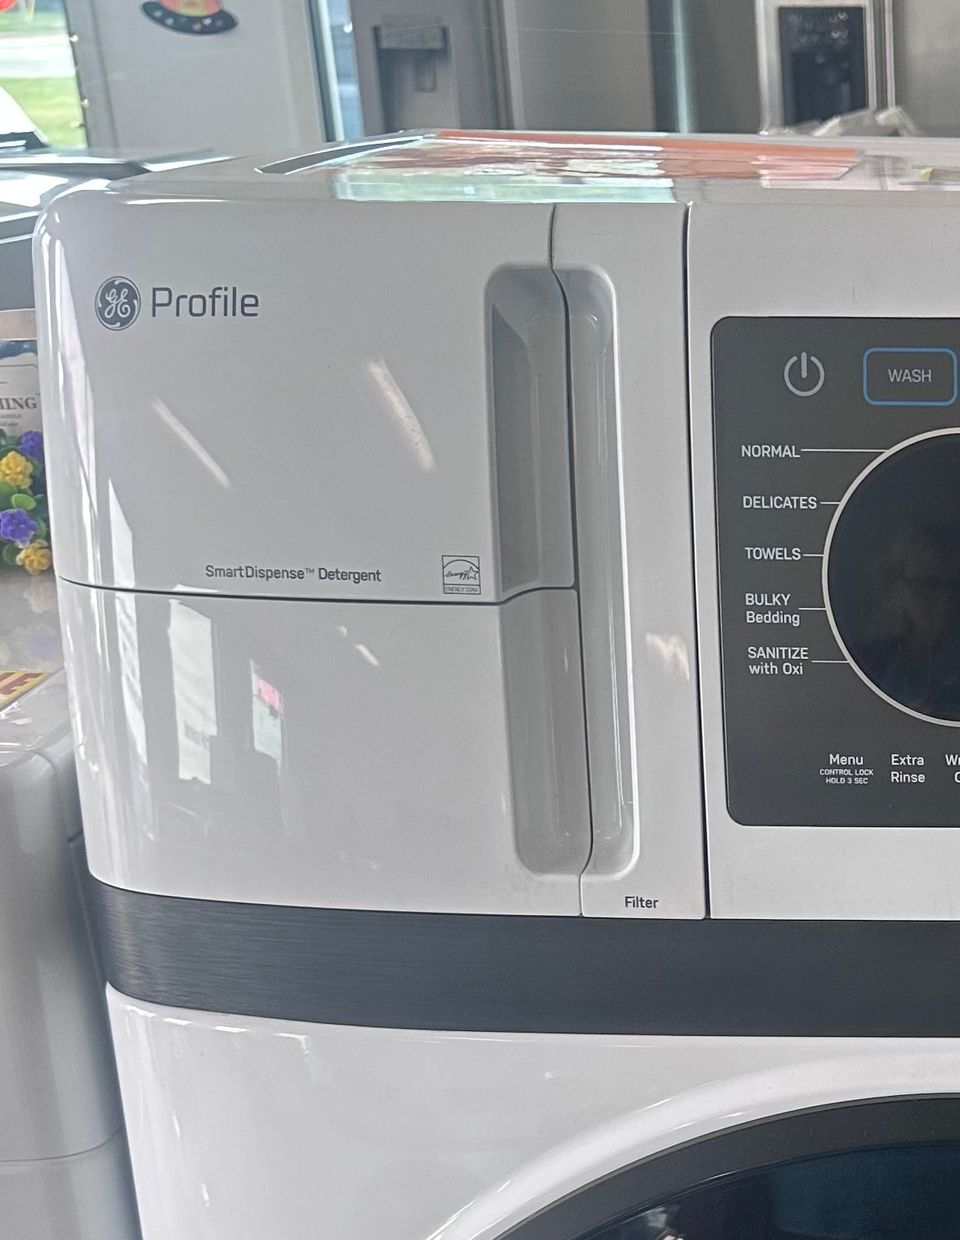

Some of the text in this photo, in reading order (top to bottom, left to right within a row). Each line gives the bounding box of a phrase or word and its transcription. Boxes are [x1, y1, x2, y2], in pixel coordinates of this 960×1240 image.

[152, 287, 259, 317] Profile
[888, 369, 932, 383] WASH
[741, 445, 801, 458] NORMAL
[743, 496, 818, 509] DELICATES
[744, 547, 802, 560] TOWELS
[318, 567, 382, 584] Detergent
[745, 593, 791, 606] BULKY
[746, 611, 800, 627] Bedding
[747, 647, 809, 660] SANITIZE
[748, 662, 804, 675] with Oxi
[829, 753, 864, 766] Menu
[891, 753, 925, 766] Extra
[819, 768, 874, 776] CONTROL LOCK
[891, 771, 926, 783] Rinse
[825, 777, 869, 785] HOLD 3 SEC
[624, 895, 659, 909] Filter
